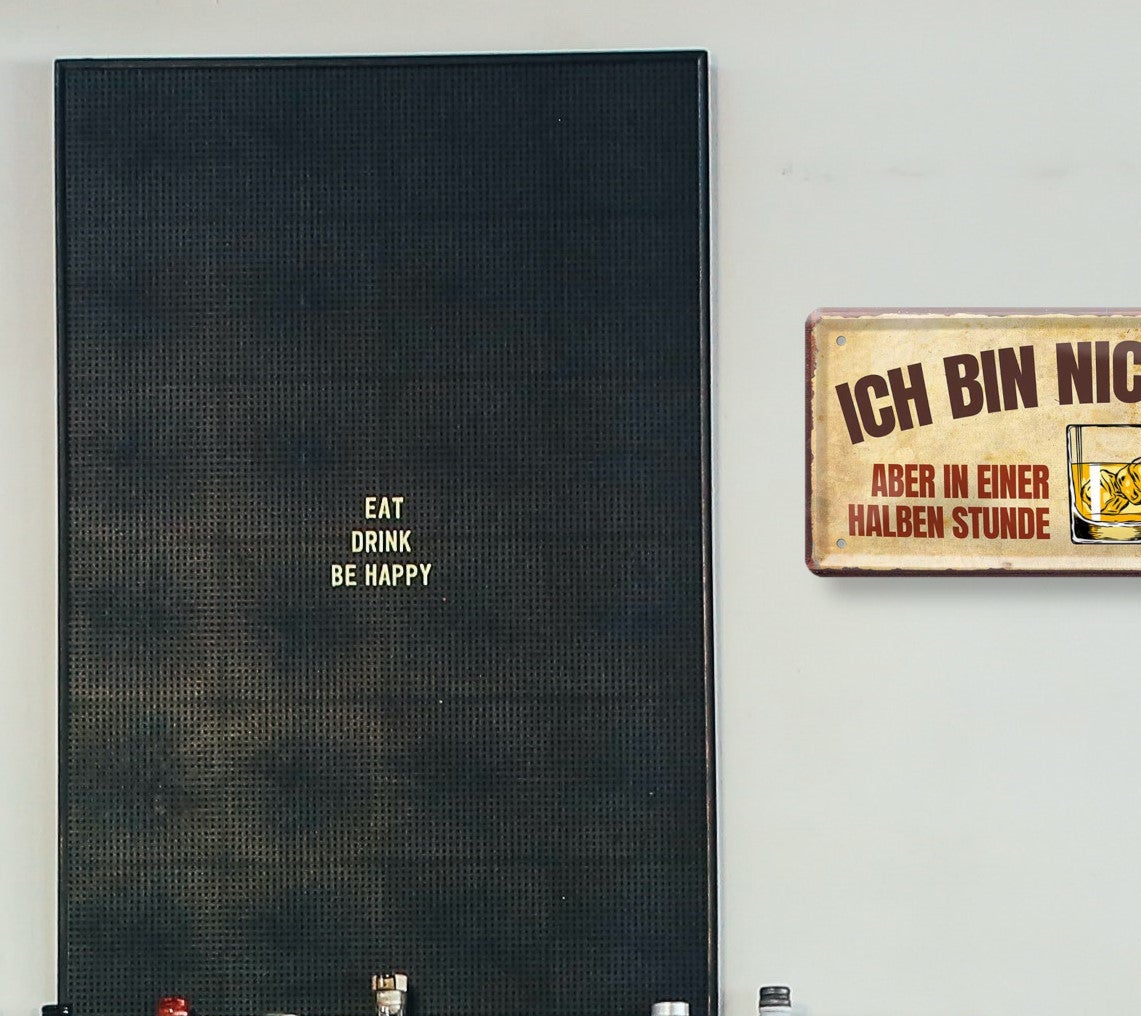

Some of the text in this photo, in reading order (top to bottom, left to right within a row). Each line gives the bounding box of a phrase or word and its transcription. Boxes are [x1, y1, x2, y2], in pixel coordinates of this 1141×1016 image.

[835, 363, 933, 444] ICH
[943, 345, 1038, 419] BIN
[871, 463, 1049, 499] ABER IN EINER
[365, 496, 404, 519] EAT
[848, 503, 1051, 540] HALBEN STUNDE
[351, 529, 411, 553] DRINK
[331, 563, 432, 587] BE HAPPY
